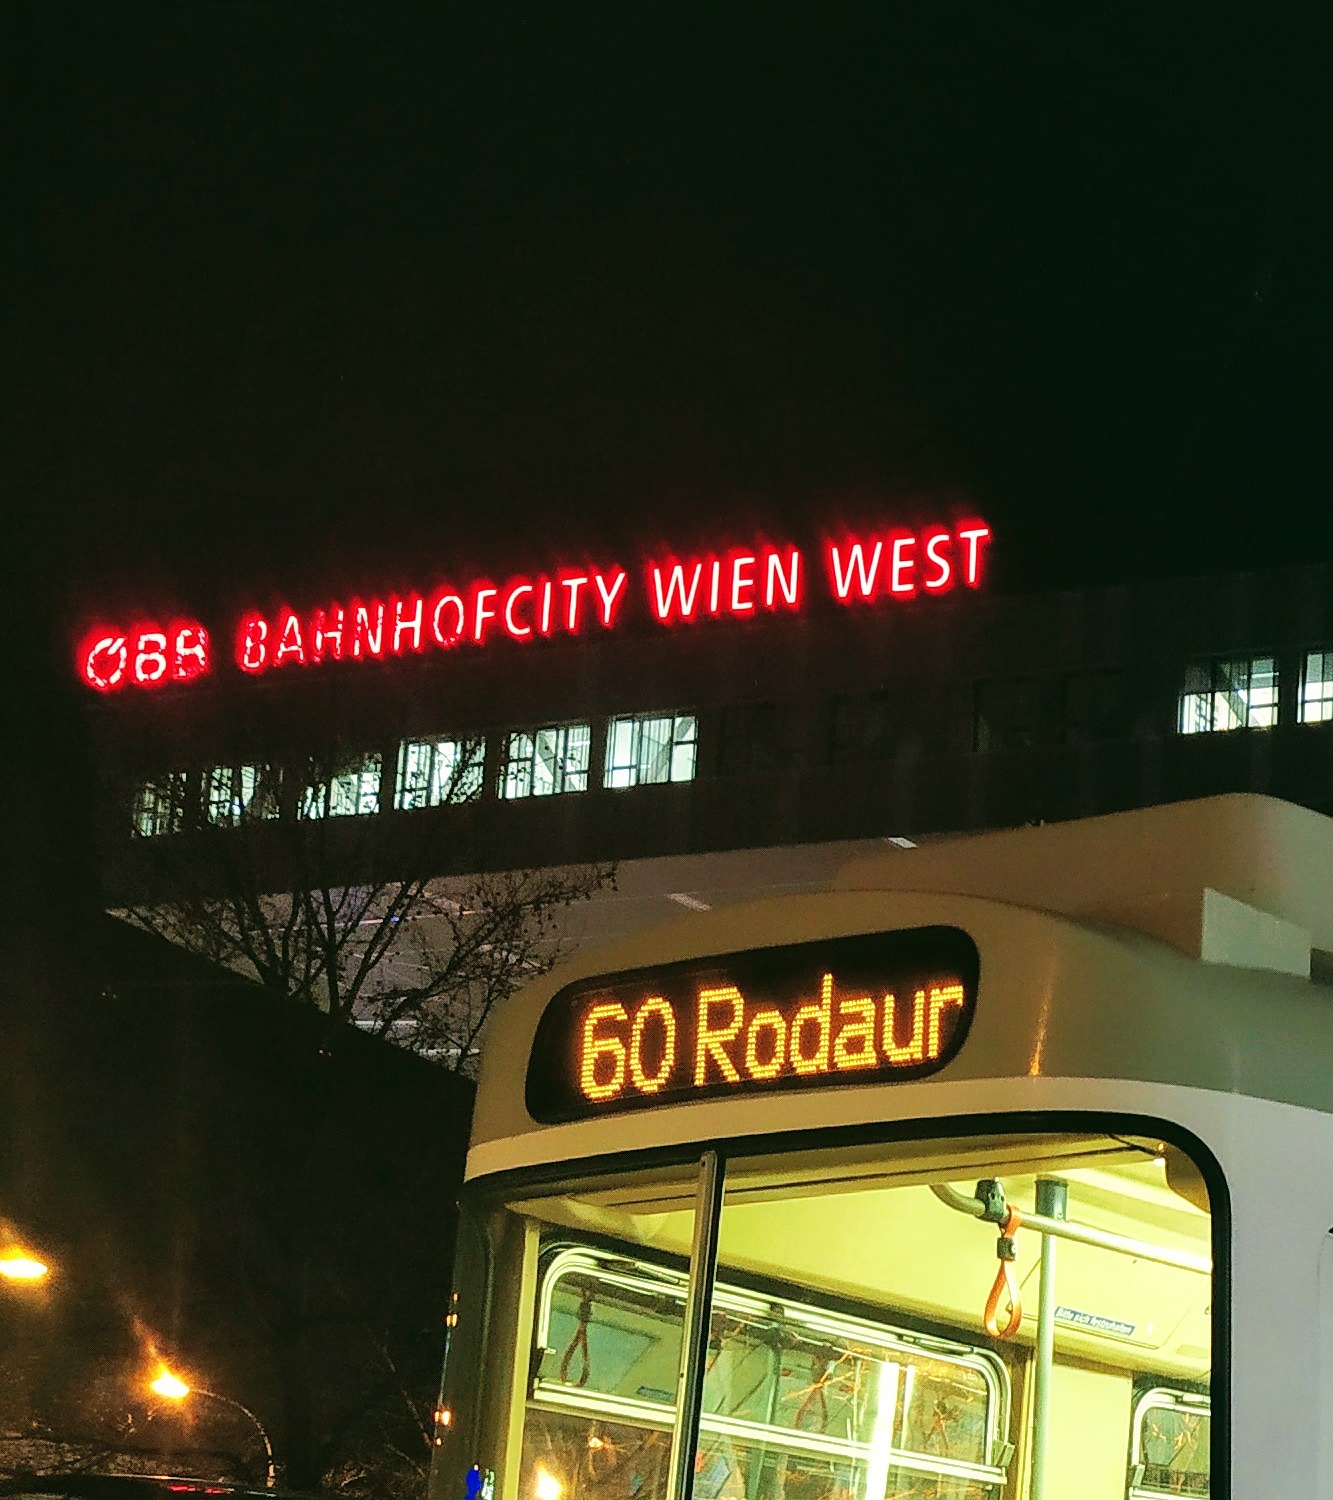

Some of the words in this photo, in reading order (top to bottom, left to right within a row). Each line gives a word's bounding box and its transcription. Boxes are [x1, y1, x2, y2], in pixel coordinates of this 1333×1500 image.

[242, 571, 627, 671] BAHNHOFCITY
[652, 550, 799, 618] WIEN
[830, 527, 990, 599] WEST
[580, 996, 676, 1102] 60
